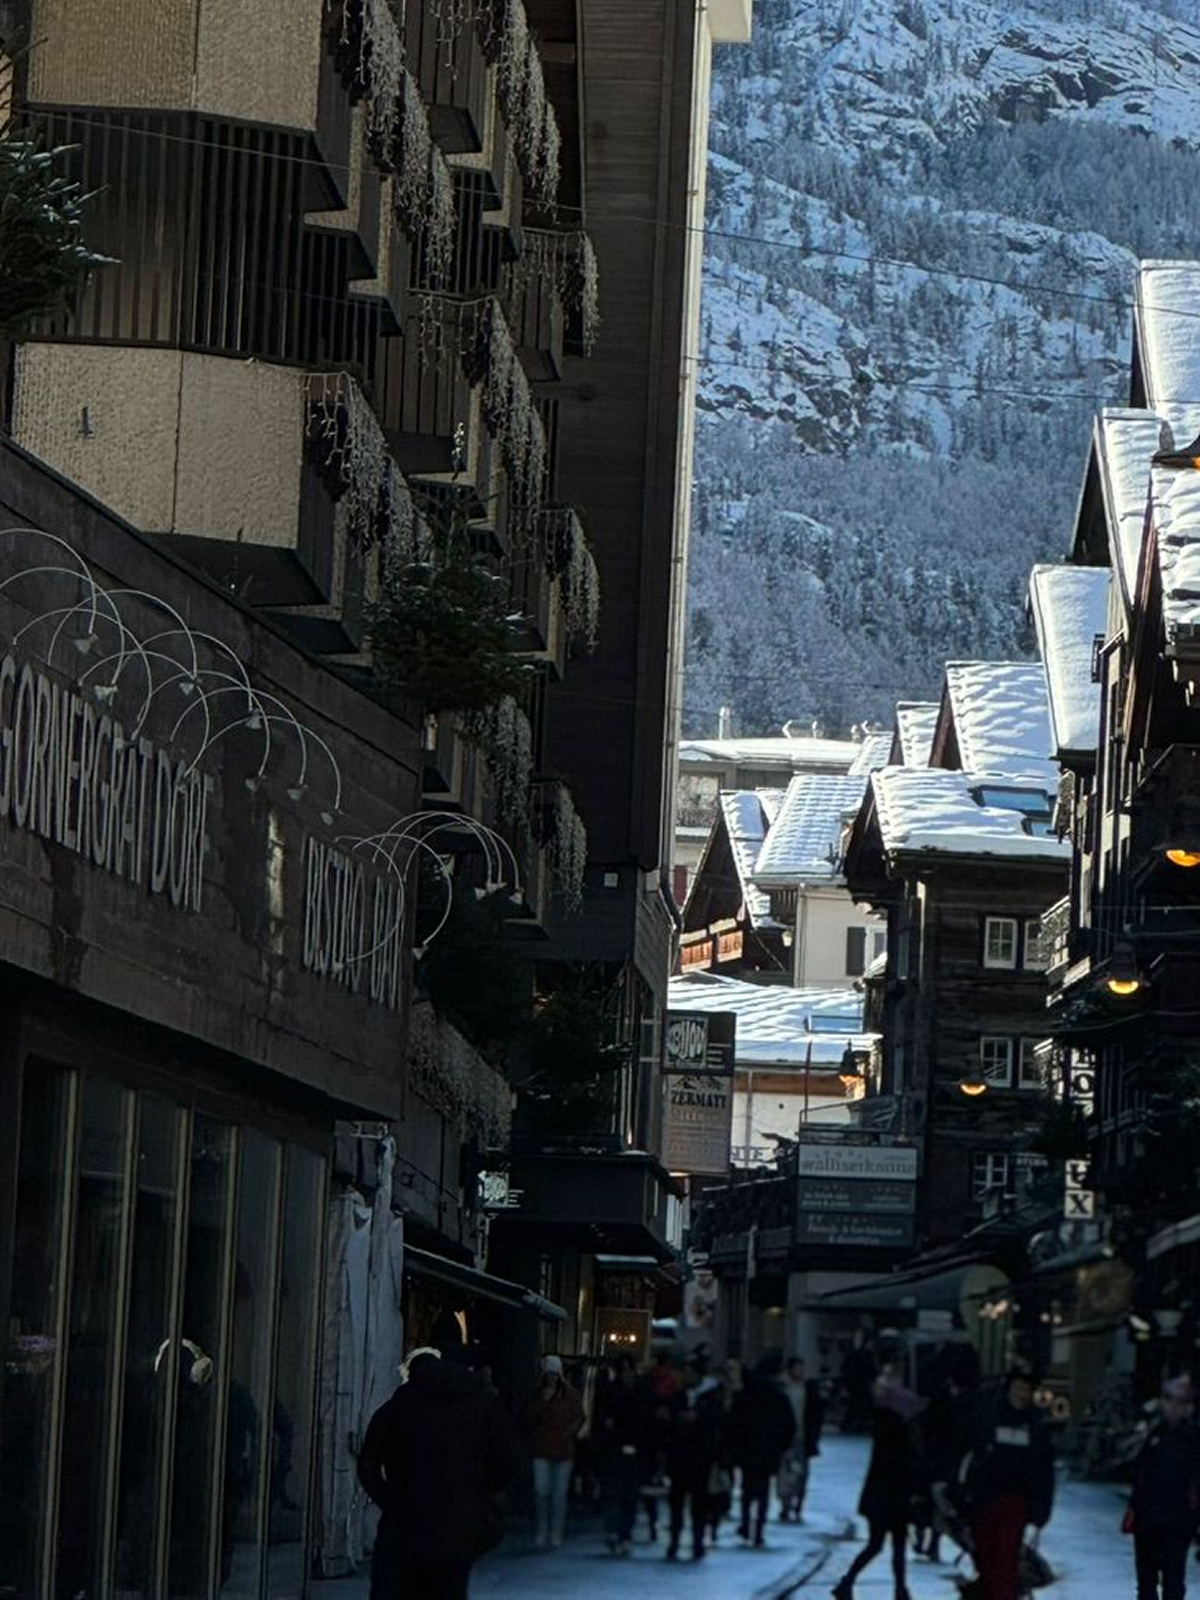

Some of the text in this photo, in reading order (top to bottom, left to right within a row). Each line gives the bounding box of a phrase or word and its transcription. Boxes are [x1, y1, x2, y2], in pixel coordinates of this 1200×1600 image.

[0, 655, 215, 913] GORNERGRAT DORF
[303, 836, 366, 994] BISTRO
[670, 1090, 727, 1109] ZERMATT
